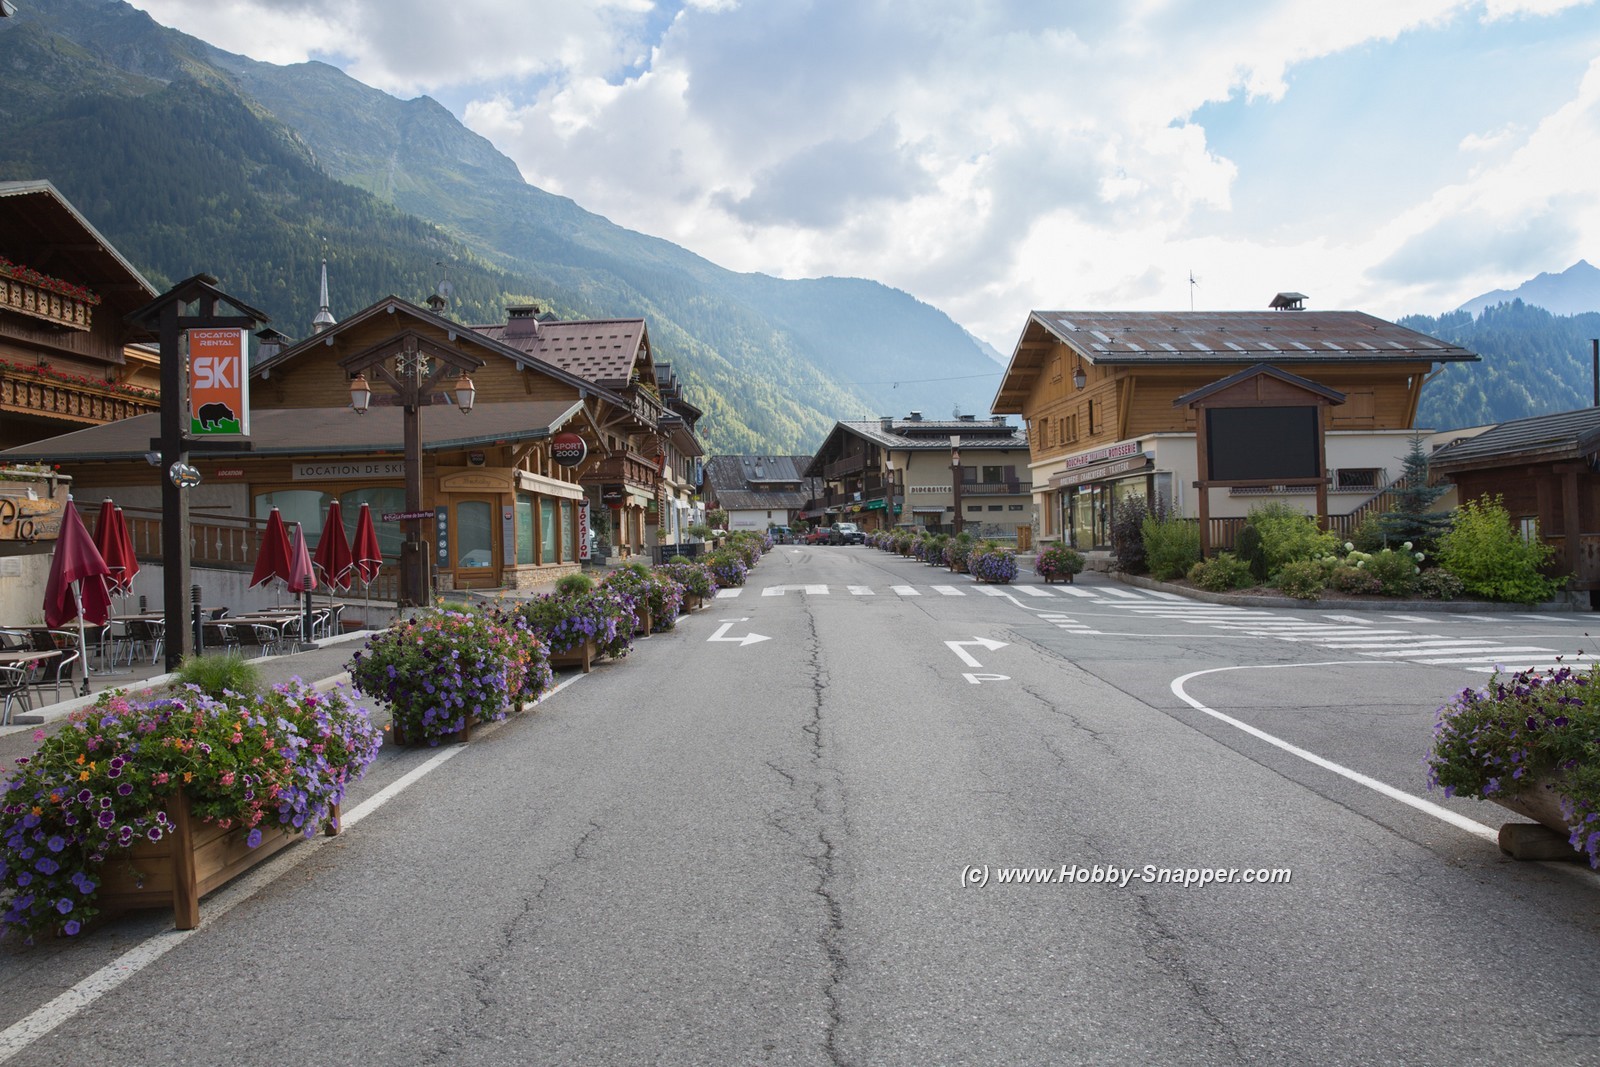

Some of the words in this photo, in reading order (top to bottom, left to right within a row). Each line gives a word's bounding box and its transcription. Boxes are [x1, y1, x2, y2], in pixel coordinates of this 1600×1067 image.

[194, 357, 239, 389] SKI
[301, 466, 359, 476] LOCATION
[366, 465, 380, 473] DE
[580, 508, 588, 558] LOCATION
